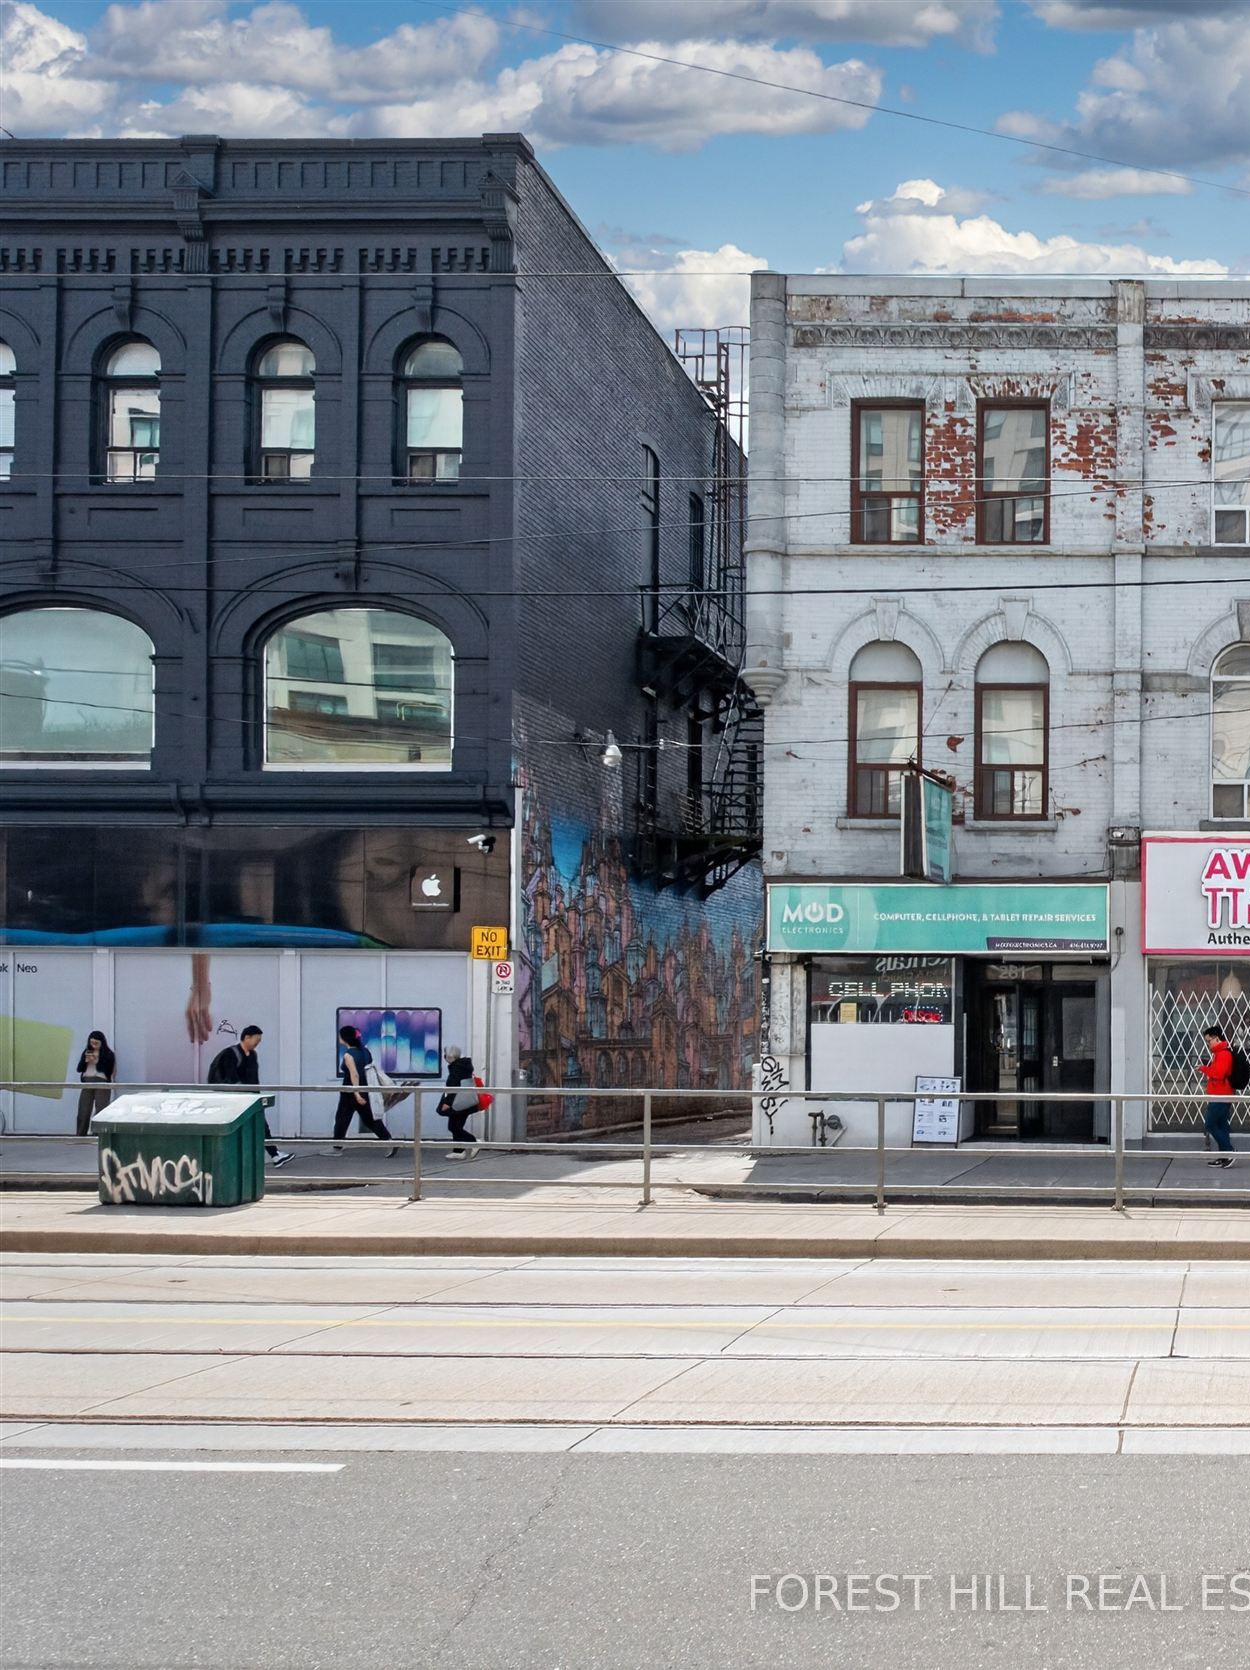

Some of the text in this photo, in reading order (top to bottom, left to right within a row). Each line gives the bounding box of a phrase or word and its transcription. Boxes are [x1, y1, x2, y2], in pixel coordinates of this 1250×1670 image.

[782, 903, 845, 923] MOD
[873, 913, 925, 922] COMPUTER,
[926, 913, 981, 922] CELLPHONE,
[990, 914, 1021, 922] TABLET
[1022, 914, 1053, 922] REPAIR
[1054, 914, 1097, 922] SERVICES
[481, 931, 498, 942] NO
[476, 945, 502, 957] EXIT
[17, 963, 38, 973] Neo
